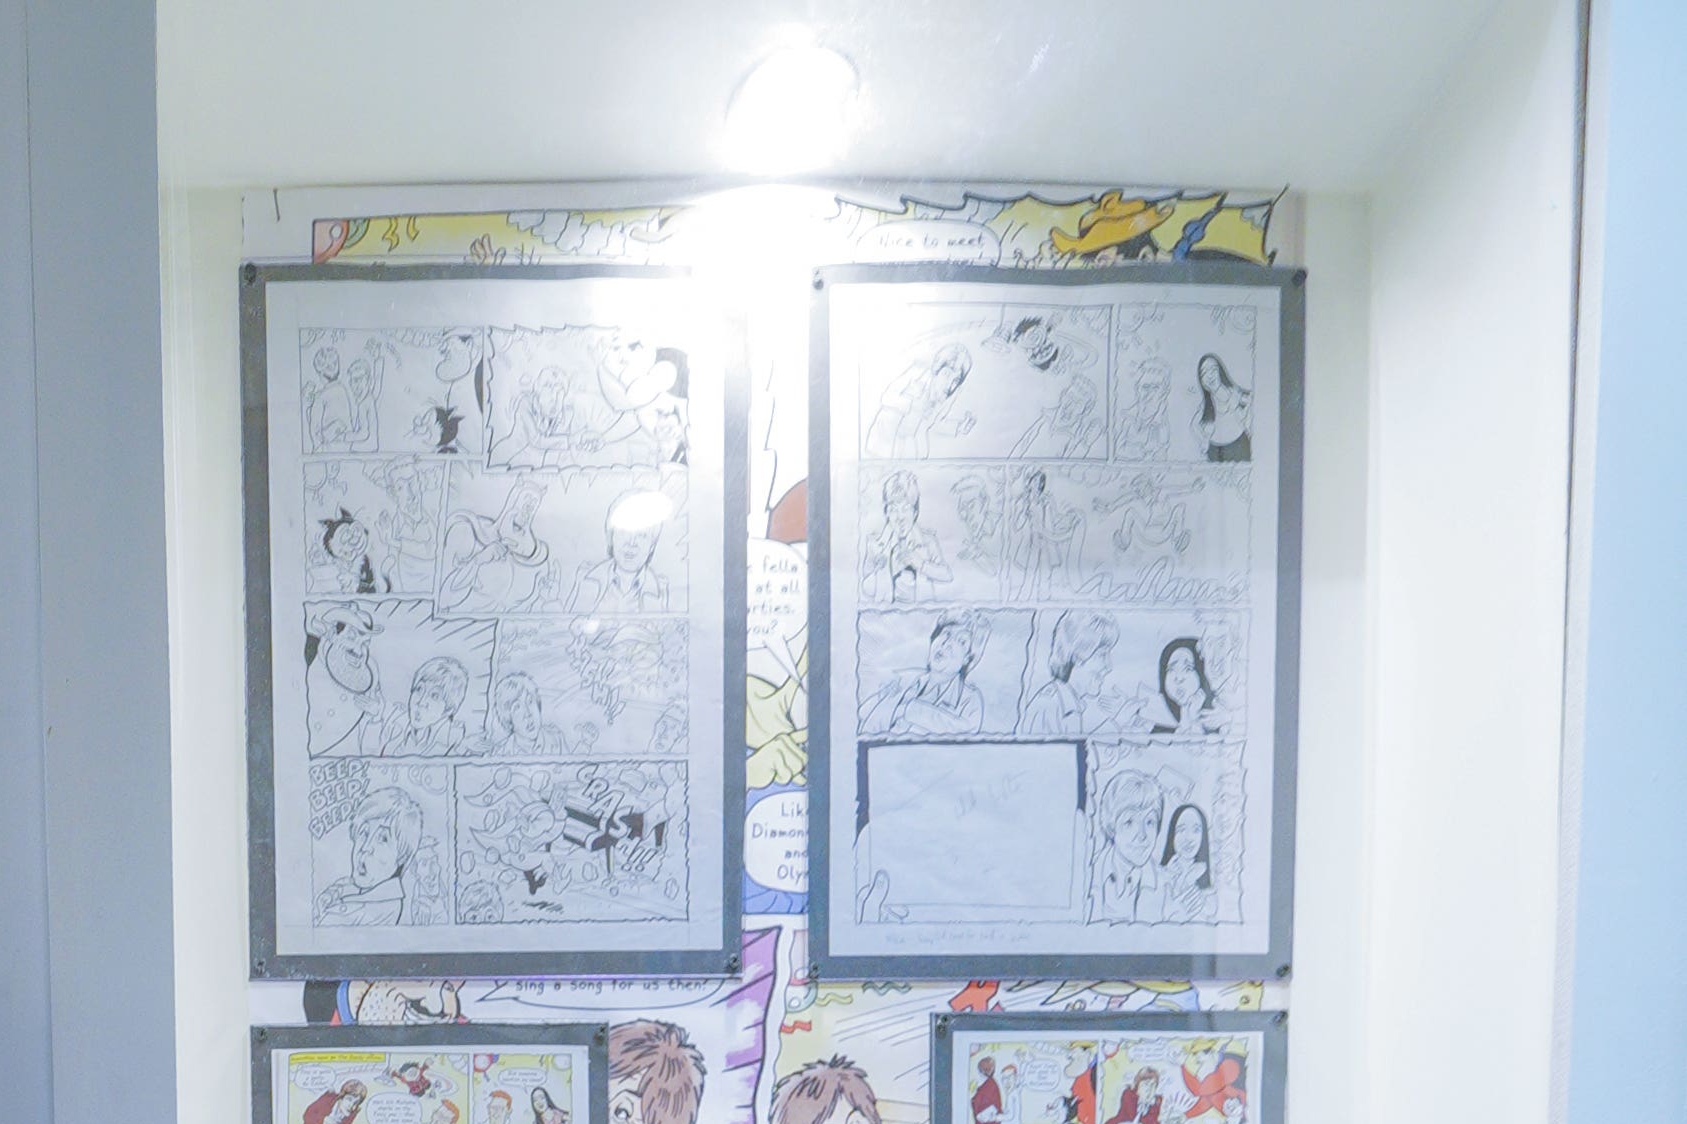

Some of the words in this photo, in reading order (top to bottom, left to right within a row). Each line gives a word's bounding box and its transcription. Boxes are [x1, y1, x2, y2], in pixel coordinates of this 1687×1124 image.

[923, 231, 939, 248] to
[755, 579, 772, 593] at
[780, 578, 801, 593] all
[308, 757, 371, 788] BEEP!
[308, 777, 372, 813] BEEP!
[308, 797, 361, 841] BEEP!
[751, 822, 808, 839] Diamon
